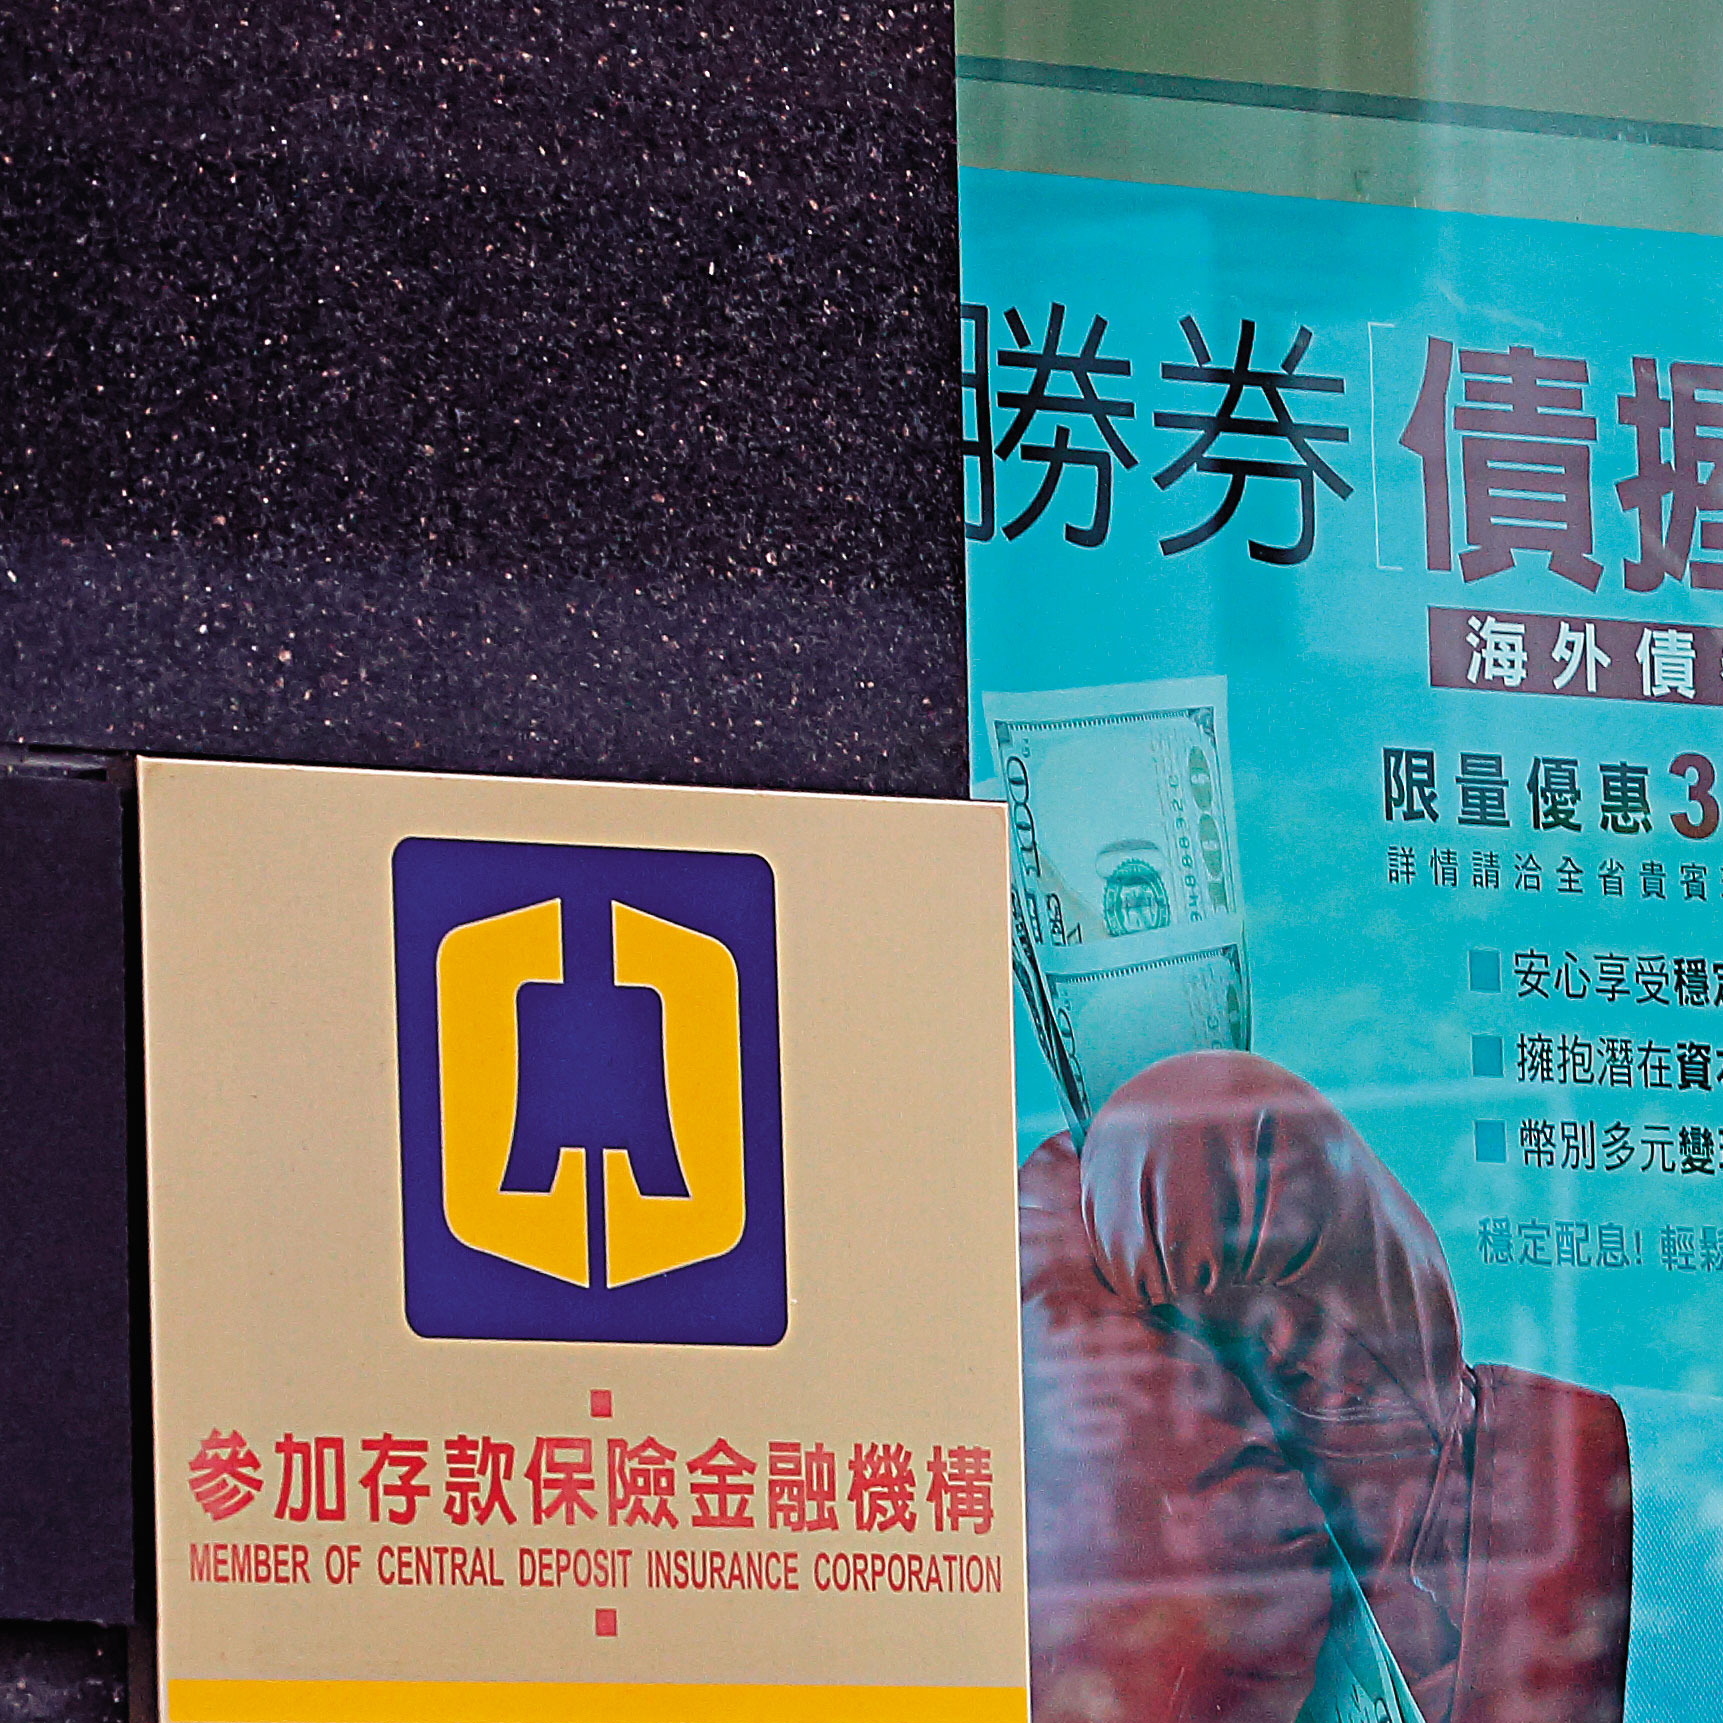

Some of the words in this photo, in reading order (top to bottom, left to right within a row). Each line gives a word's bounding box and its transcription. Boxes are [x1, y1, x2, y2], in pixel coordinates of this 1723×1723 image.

[958, 302, 1355, 566] 勝券
[187, 1428, 997, 1537] 參加存款保險金融機構
[190, 1543, 310, 1584] MEMBER
[324, 1545, 362, 1586] OF
[377, 1545, 504, 1587] CENTRAL
[518, 1547, 632, 1589] DEPOSIT
[647, 1550, 799, 1591] INSURANCE
[813, 1553, 1002, 1594] CORPORATION
